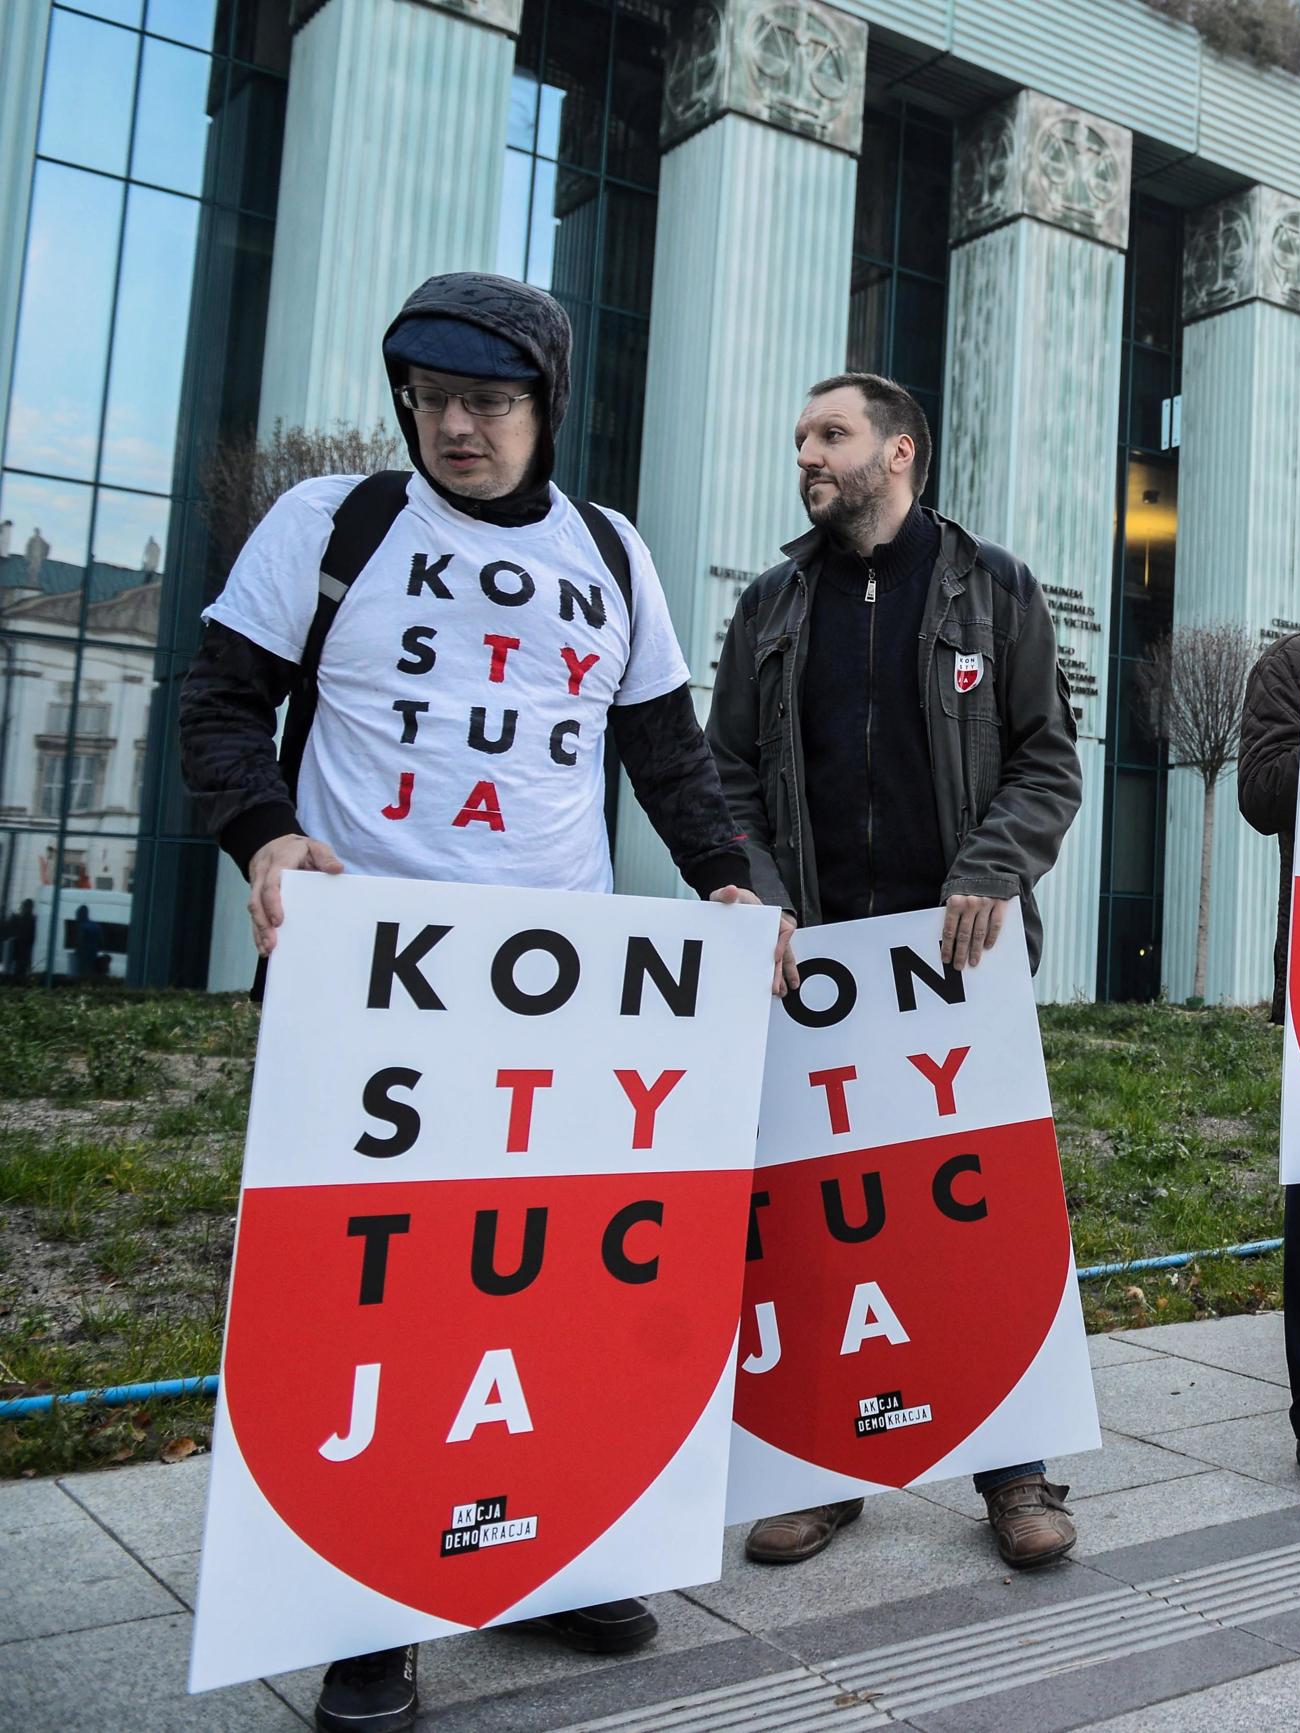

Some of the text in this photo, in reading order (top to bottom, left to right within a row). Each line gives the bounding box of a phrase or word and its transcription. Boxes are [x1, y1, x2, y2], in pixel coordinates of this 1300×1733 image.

[406, 552, 607, 630] KON
[396, 625, 600, 697] STY
[392, 700, 581, 767] TUC
[380, 772, 506, 832] JA
[366, 921, 704, 1018] KON
[781, 946, 967, 1029] ON
[353, 1067, 687, 1158] STY
[808, 1046, 972, 1135] TY
[346, 1200, 665, 1306] TUC
[741, 1281, 912, 1375] JA
[318, 1348, 534, 1462] JA
[858, 1408, 928, 1433] DEMOKRACJA
[864, 1396, 899, 1414] AKCJA
[445, 1521, 532, 1550] DEMOKRACJA
[457, 1503, 501, 1525] AKCJA
